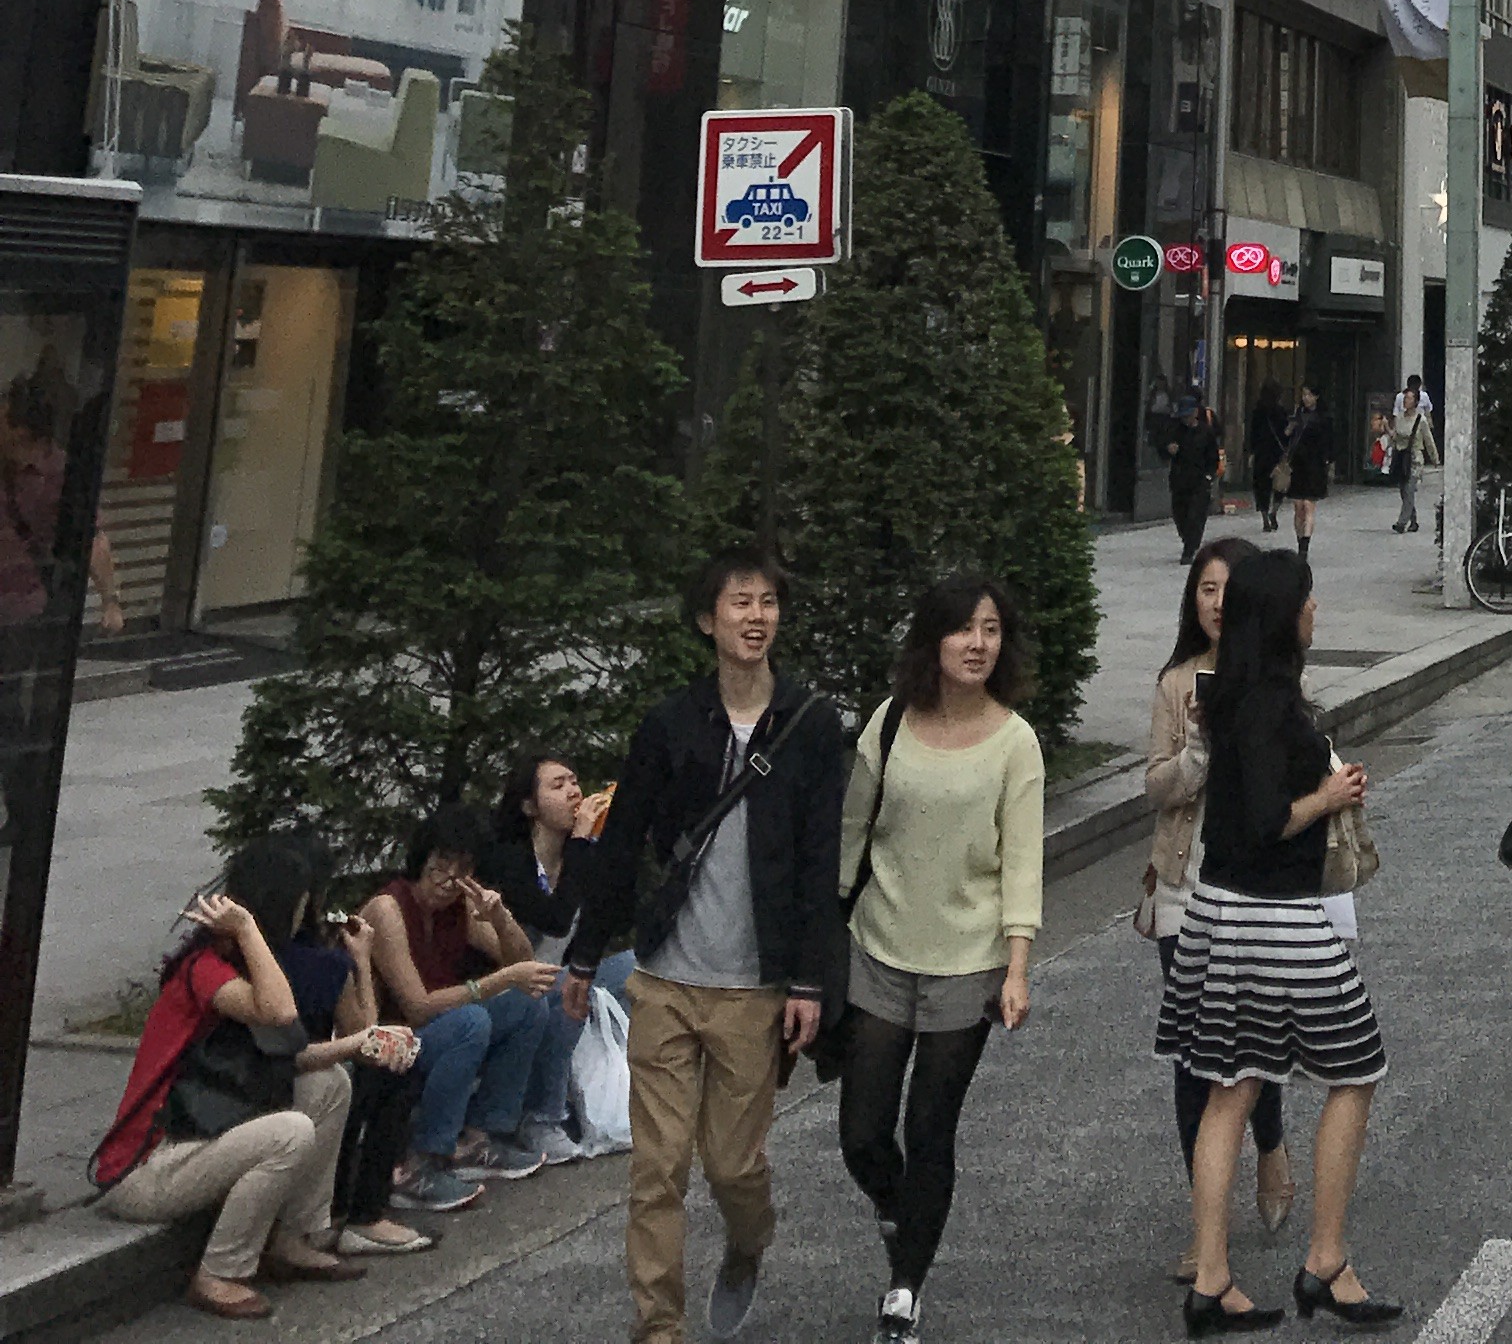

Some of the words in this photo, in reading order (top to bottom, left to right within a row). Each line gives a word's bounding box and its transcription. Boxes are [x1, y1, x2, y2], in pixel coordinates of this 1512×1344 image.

[722, 135, 778, 152] タクシー
[721, 152, 777, 169] 乗車禁止
[751, 202, 784, 216] TAXI
[761, 225, 804, 241] 22-1
[1116, 255, 1155, 269] Quark
